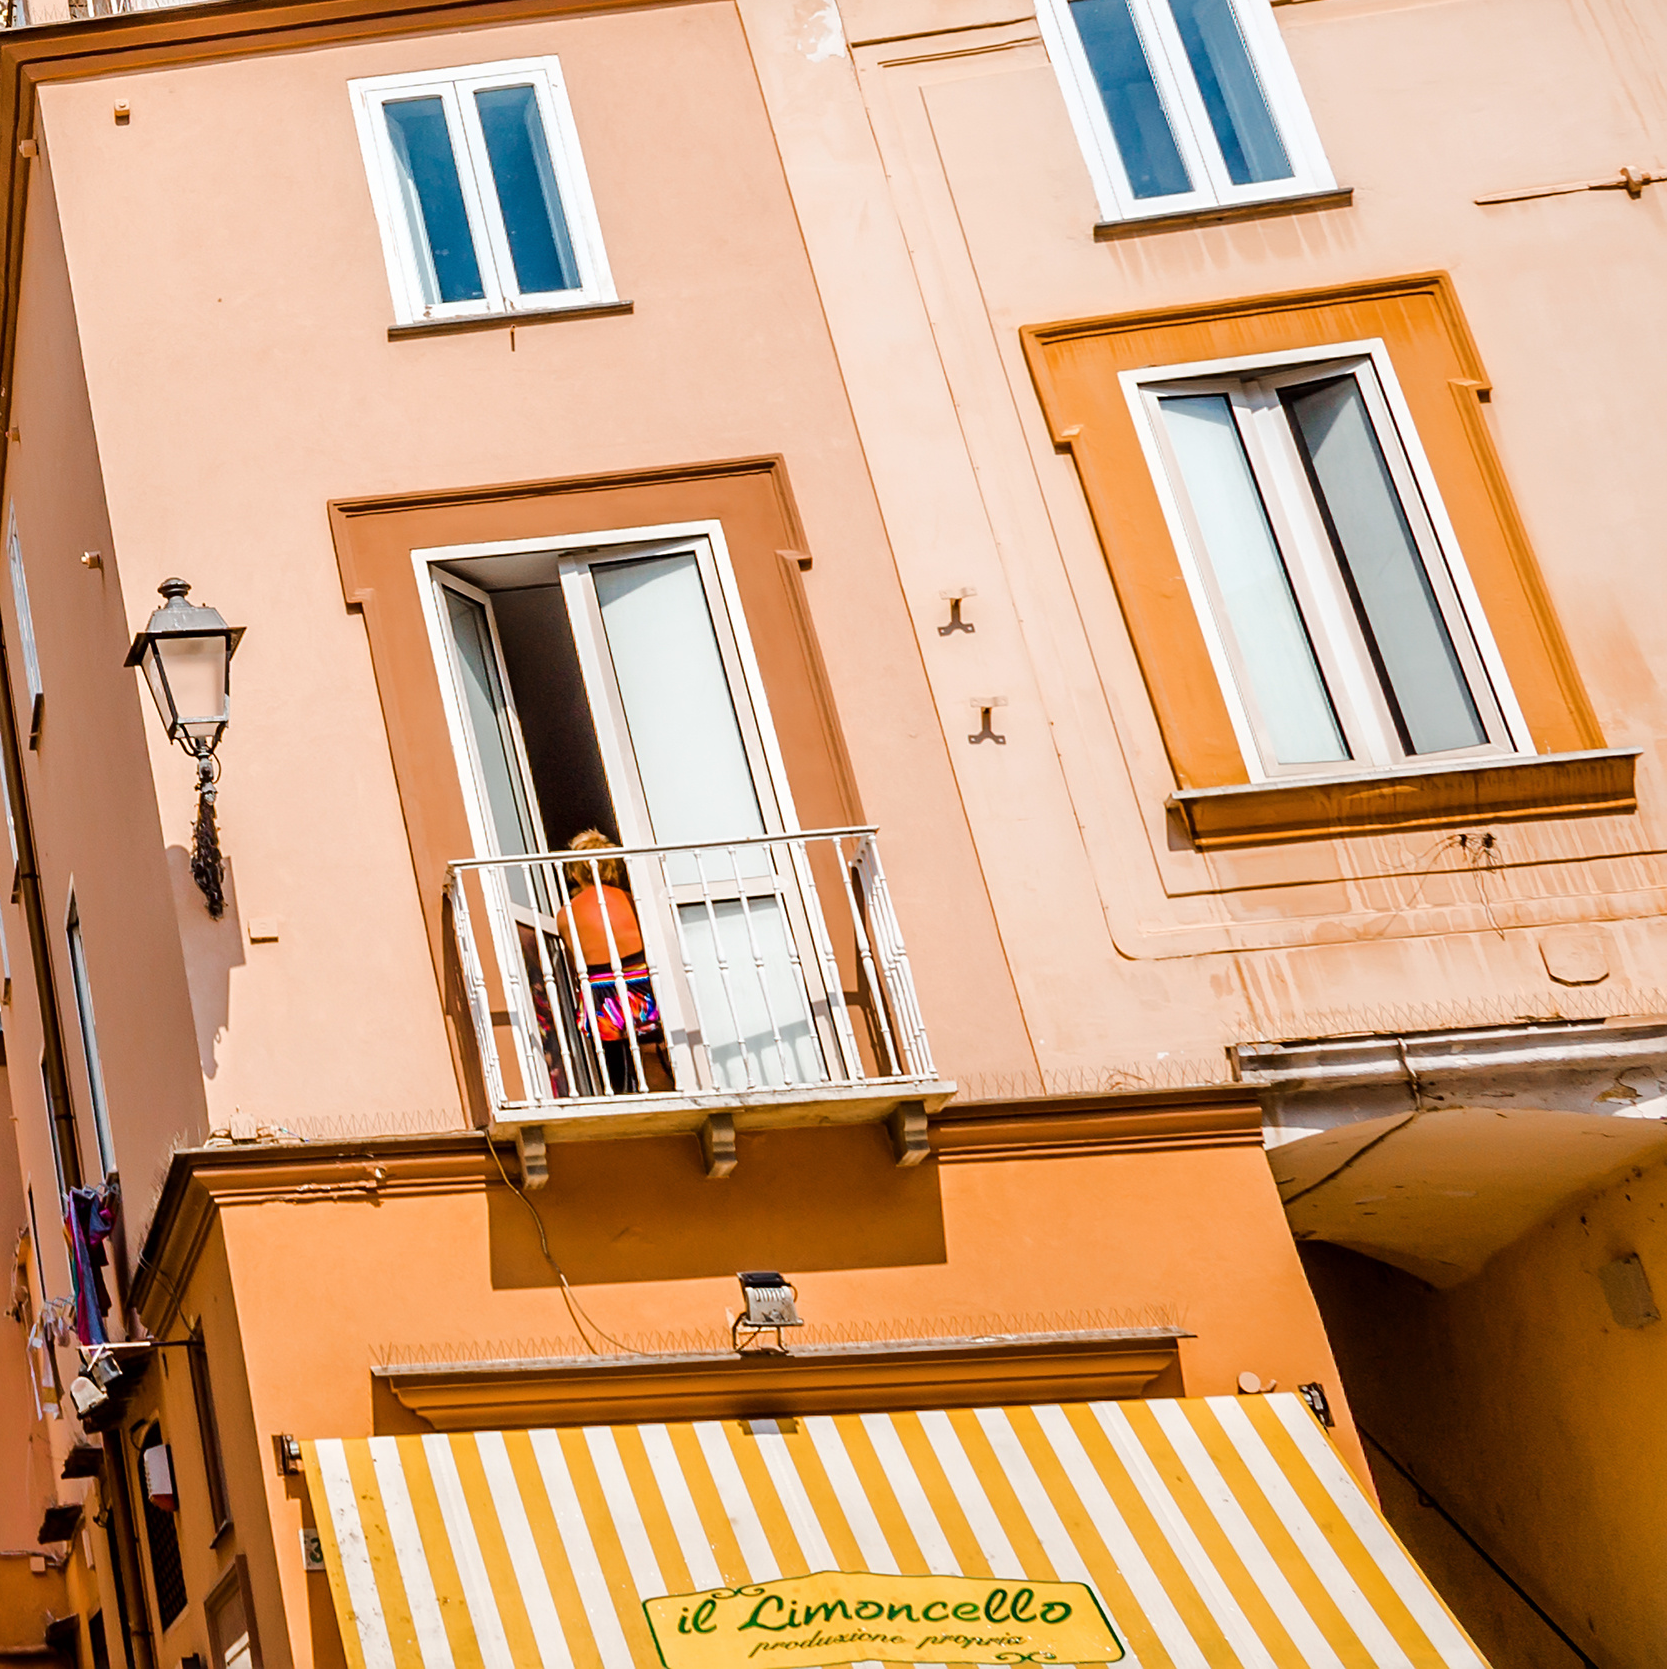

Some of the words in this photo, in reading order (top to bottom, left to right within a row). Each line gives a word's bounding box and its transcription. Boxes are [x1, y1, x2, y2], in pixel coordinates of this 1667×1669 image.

[678, 1598, 718, 1634] il
[737, 1588, 1072, 1632] Limoncello
[748, 1629, 906, 1658] produzione
[915, 1632, 1025, 1650] propria
